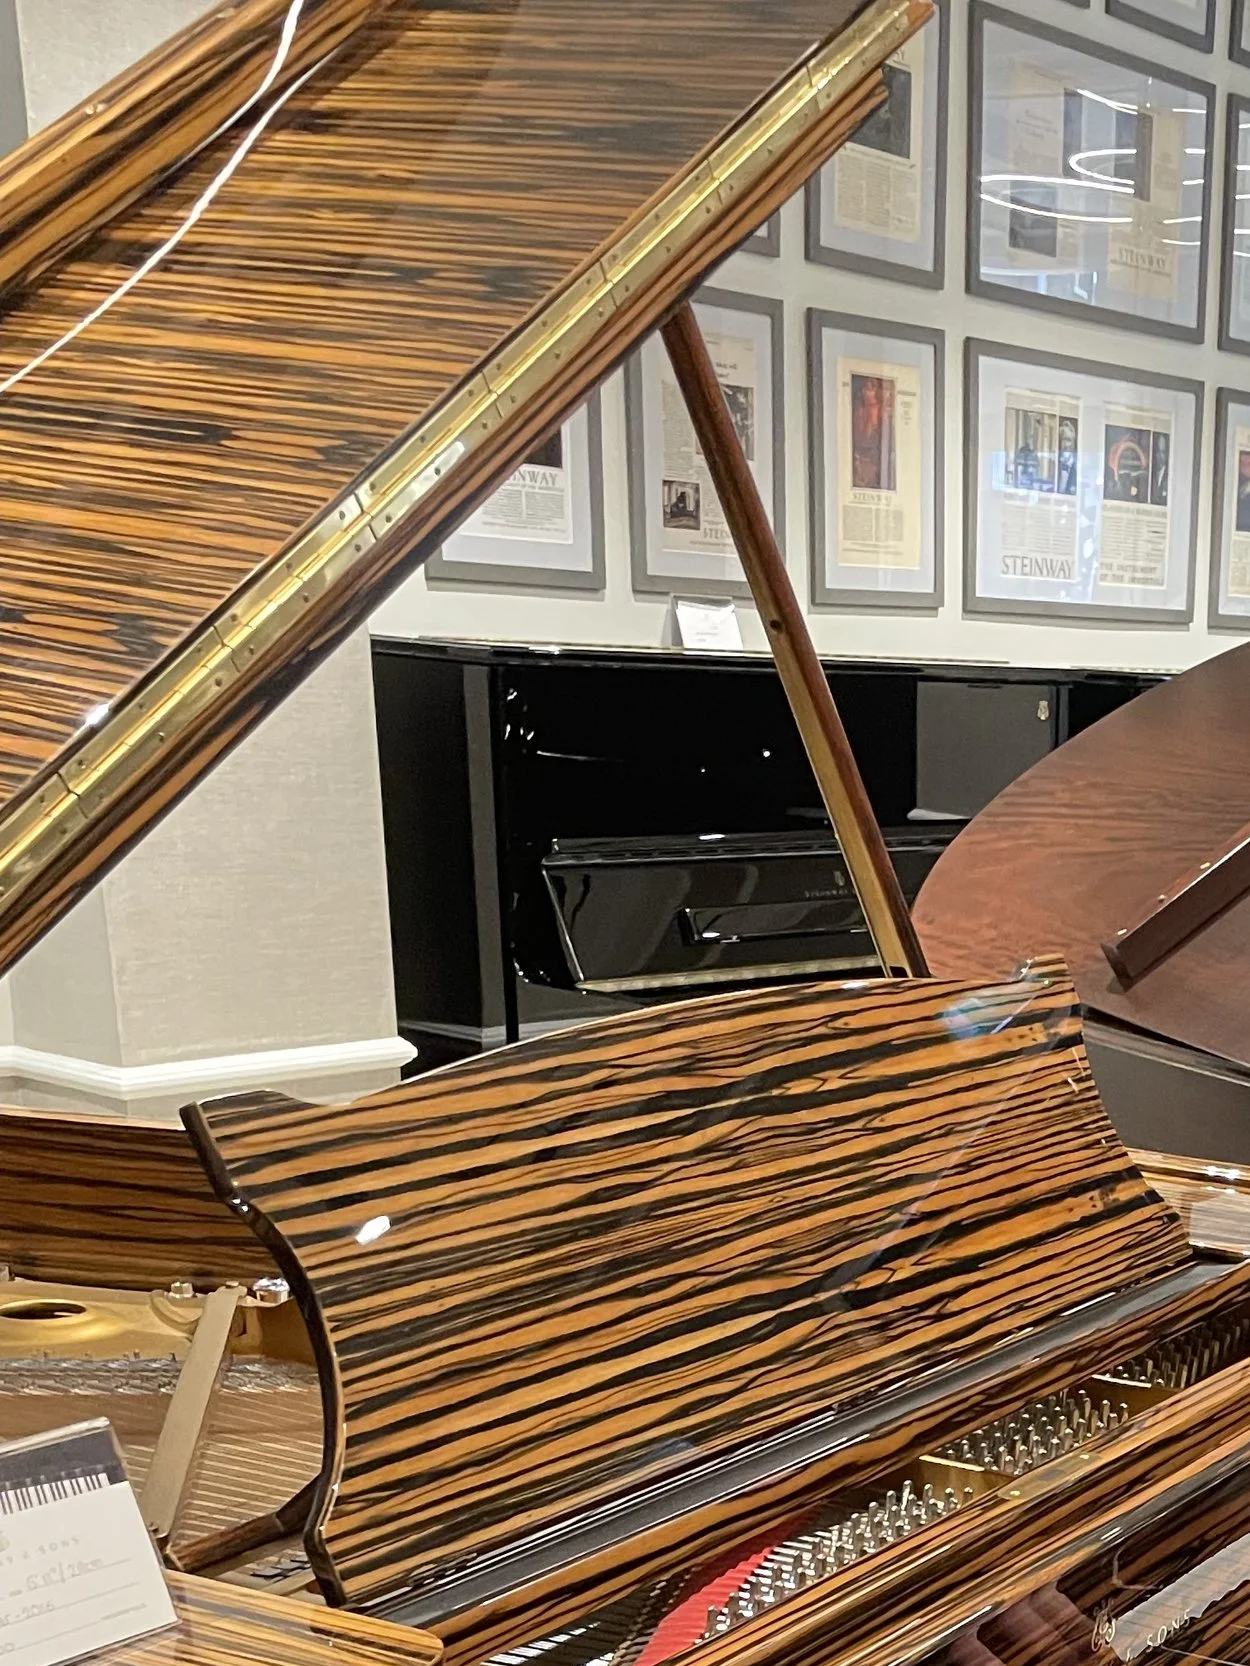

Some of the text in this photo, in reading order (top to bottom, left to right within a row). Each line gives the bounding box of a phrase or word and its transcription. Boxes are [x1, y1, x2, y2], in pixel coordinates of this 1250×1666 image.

[512, 469, 558, 486] INWAY
[1001, 554, 1076, 580] STEINWAY
[1146, 1608, 1191, 1653] SONS
